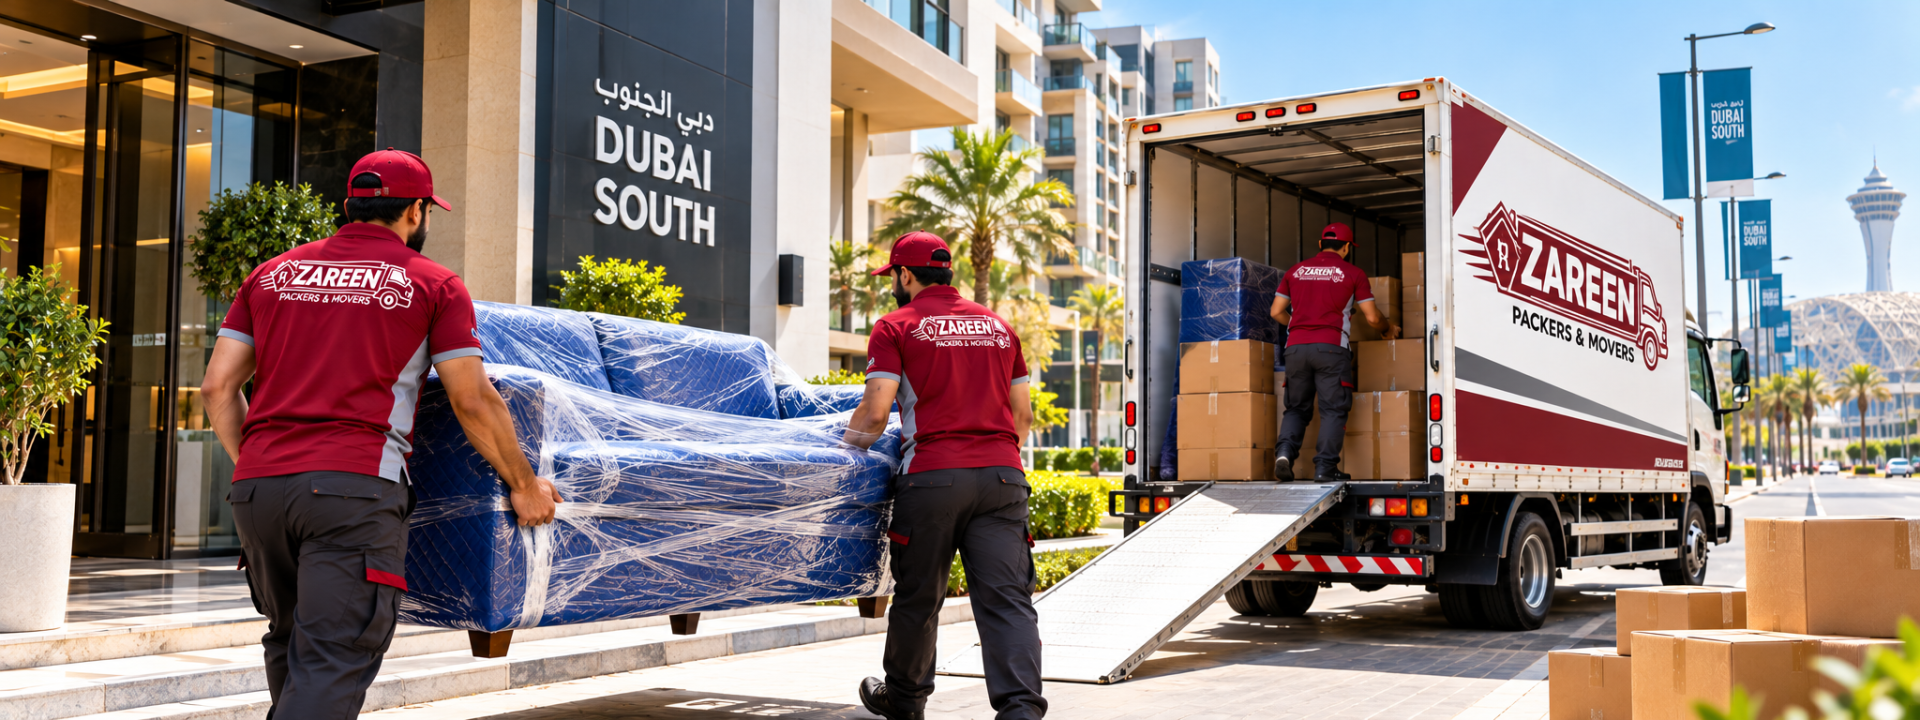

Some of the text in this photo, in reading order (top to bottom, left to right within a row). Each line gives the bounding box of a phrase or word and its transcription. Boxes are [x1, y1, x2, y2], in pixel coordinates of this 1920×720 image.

[595, 78, 714, 136] دبي الجنوب
[1711, 108, 1744, 124] DUBAI
[1711, 124, 1745, 139] SOUTH
[596, 115, 711, 192] DUBAI
[593, 177, 715, 247] SOUTH
[1743, 225, 1767, 236] DUBAI
[1743, 236, 1768, 246] SOUTH
[291, 264, 382, 289] ZAREEN
[1521, 232, 1635, 326] ZAREEN
[278, 292, 372, 306] PACKERS & MOVERS
[936, 320, 992, 335] ZAREEN
[1512, 305, 1636, 363] PACKERS & MOVERS
